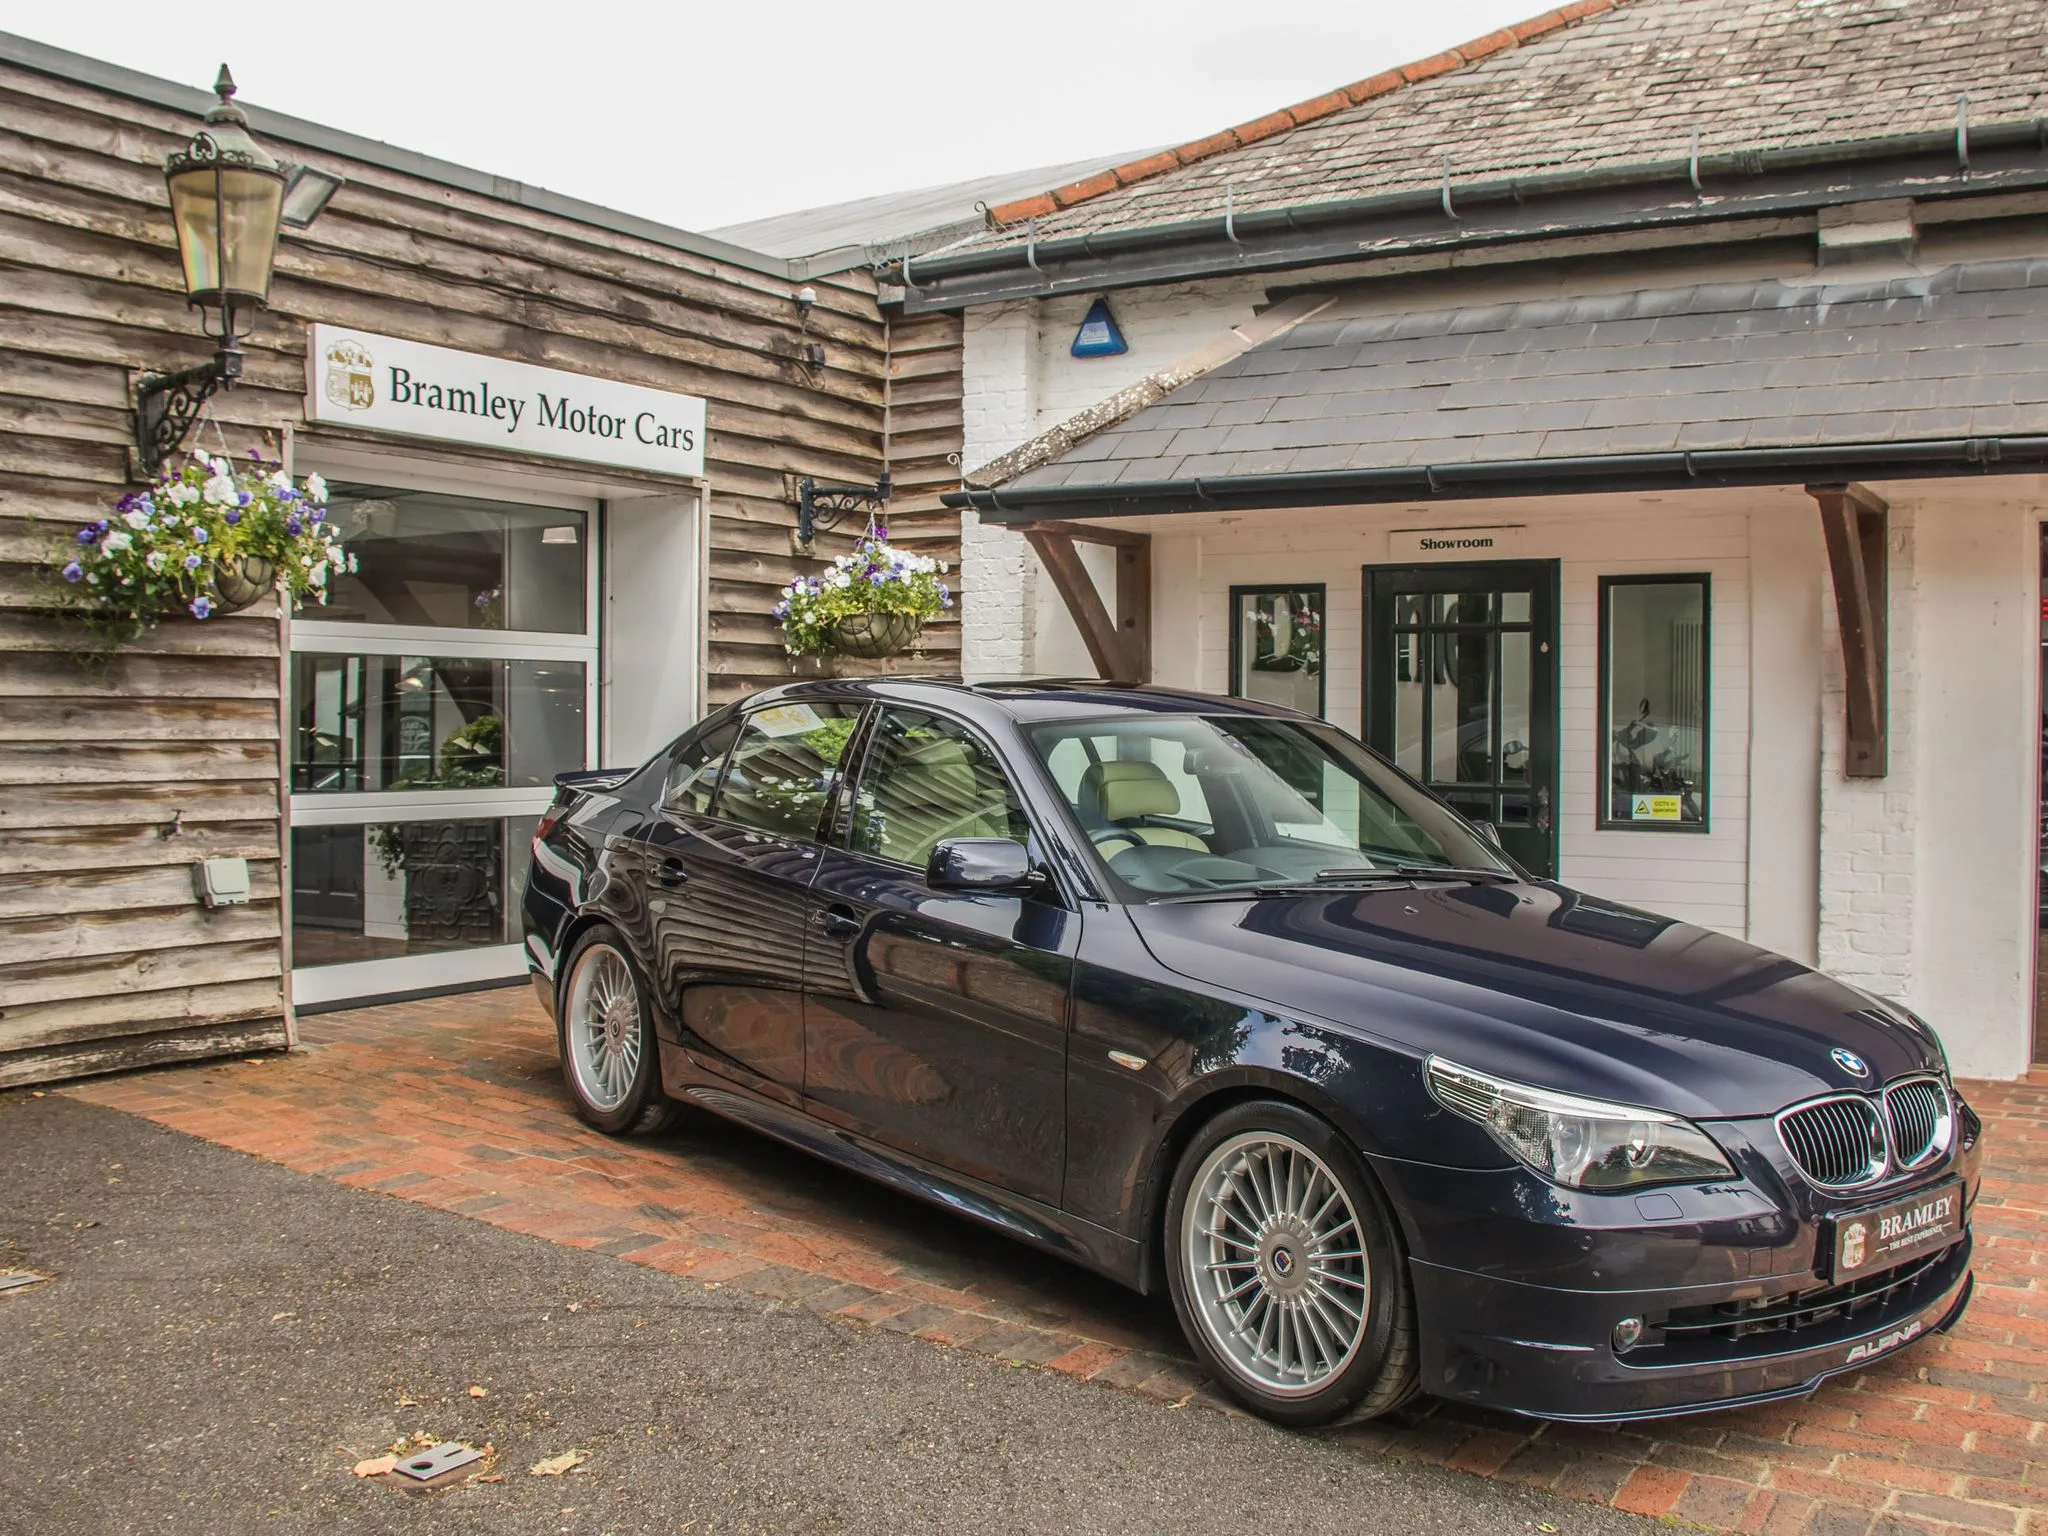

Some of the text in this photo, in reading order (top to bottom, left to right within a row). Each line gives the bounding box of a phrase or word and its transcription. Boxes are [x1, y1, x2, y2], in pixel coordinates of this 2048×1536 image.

[389, 366, 694, 452] Bramley Motor Cars
[1420, 538, 1494, 550] Showroom
[1880, 1195, 1953, 1240] BRAMLEY
[1846, 1320, 1921, 1363] ALPINA
